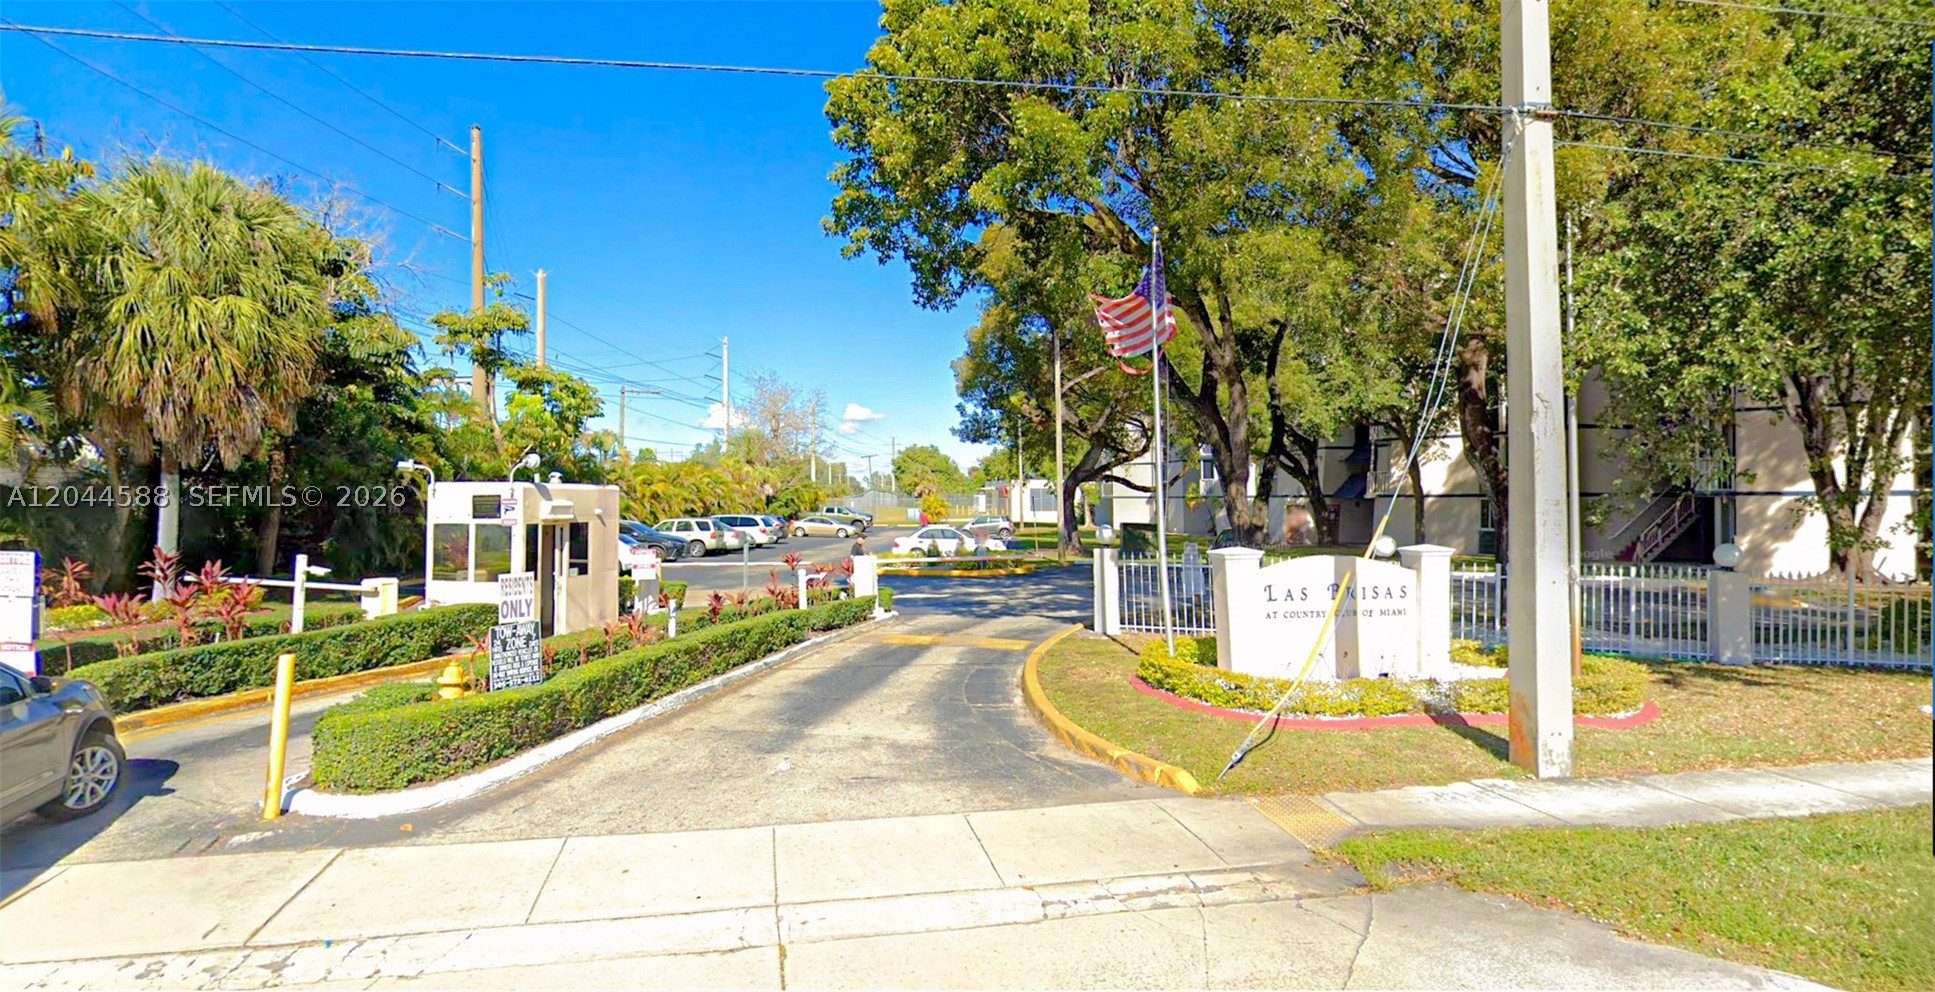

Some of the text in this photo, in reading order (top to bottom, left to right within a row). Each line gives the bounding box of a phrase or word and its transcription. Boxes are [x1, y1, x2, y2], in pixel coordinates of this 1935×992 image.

[500, 573, 534, 597] RESIDENTS
[501, 598, 533, 619] ONLY
[1265, 611, 1278, 619] AT
[1283, 610, 1326, 619] COUNTRY
[1362, 609, 1373, 617] OF
[1379, 608, 1406, 617] MIAMI
[495, 622, 535, 639] TOW-AWAY
[505, 636, 527, 650] ZONE
